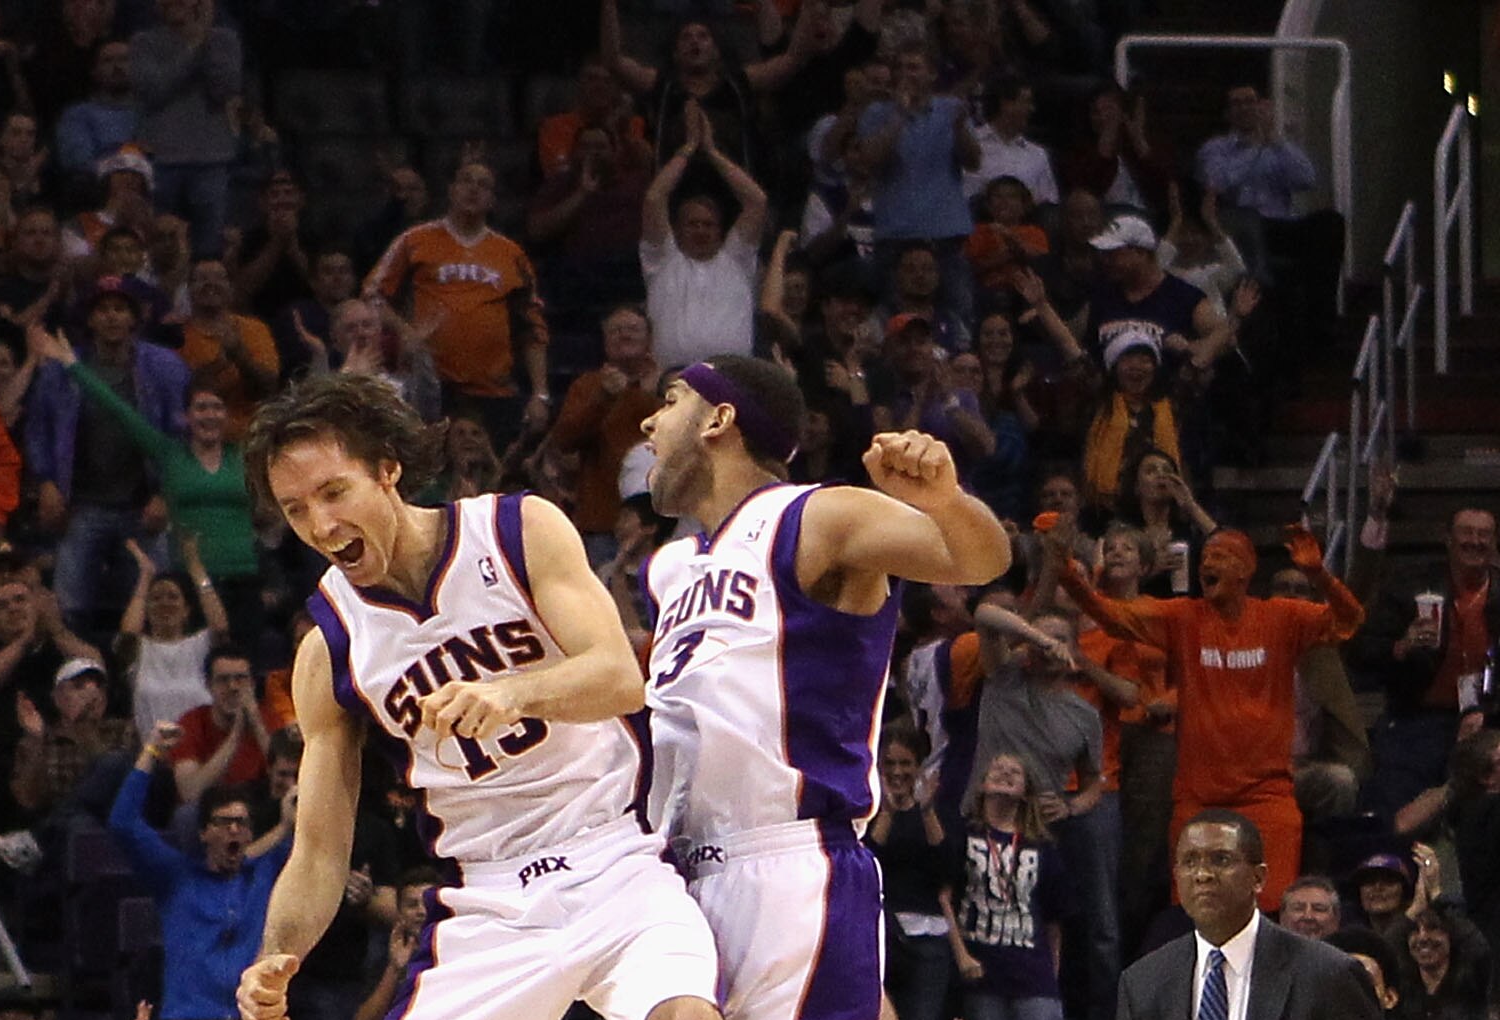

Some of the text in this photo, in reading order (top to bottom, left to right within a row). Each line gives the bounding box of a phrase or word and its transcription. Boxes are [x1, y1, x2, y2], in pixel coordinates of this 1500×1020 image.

[437, 262, 503, 289] PHX
[653, 568, 759, 647] SUNS
[384, 618, 546, 739] SUNS
[518, 855, 573, 889] PHX
